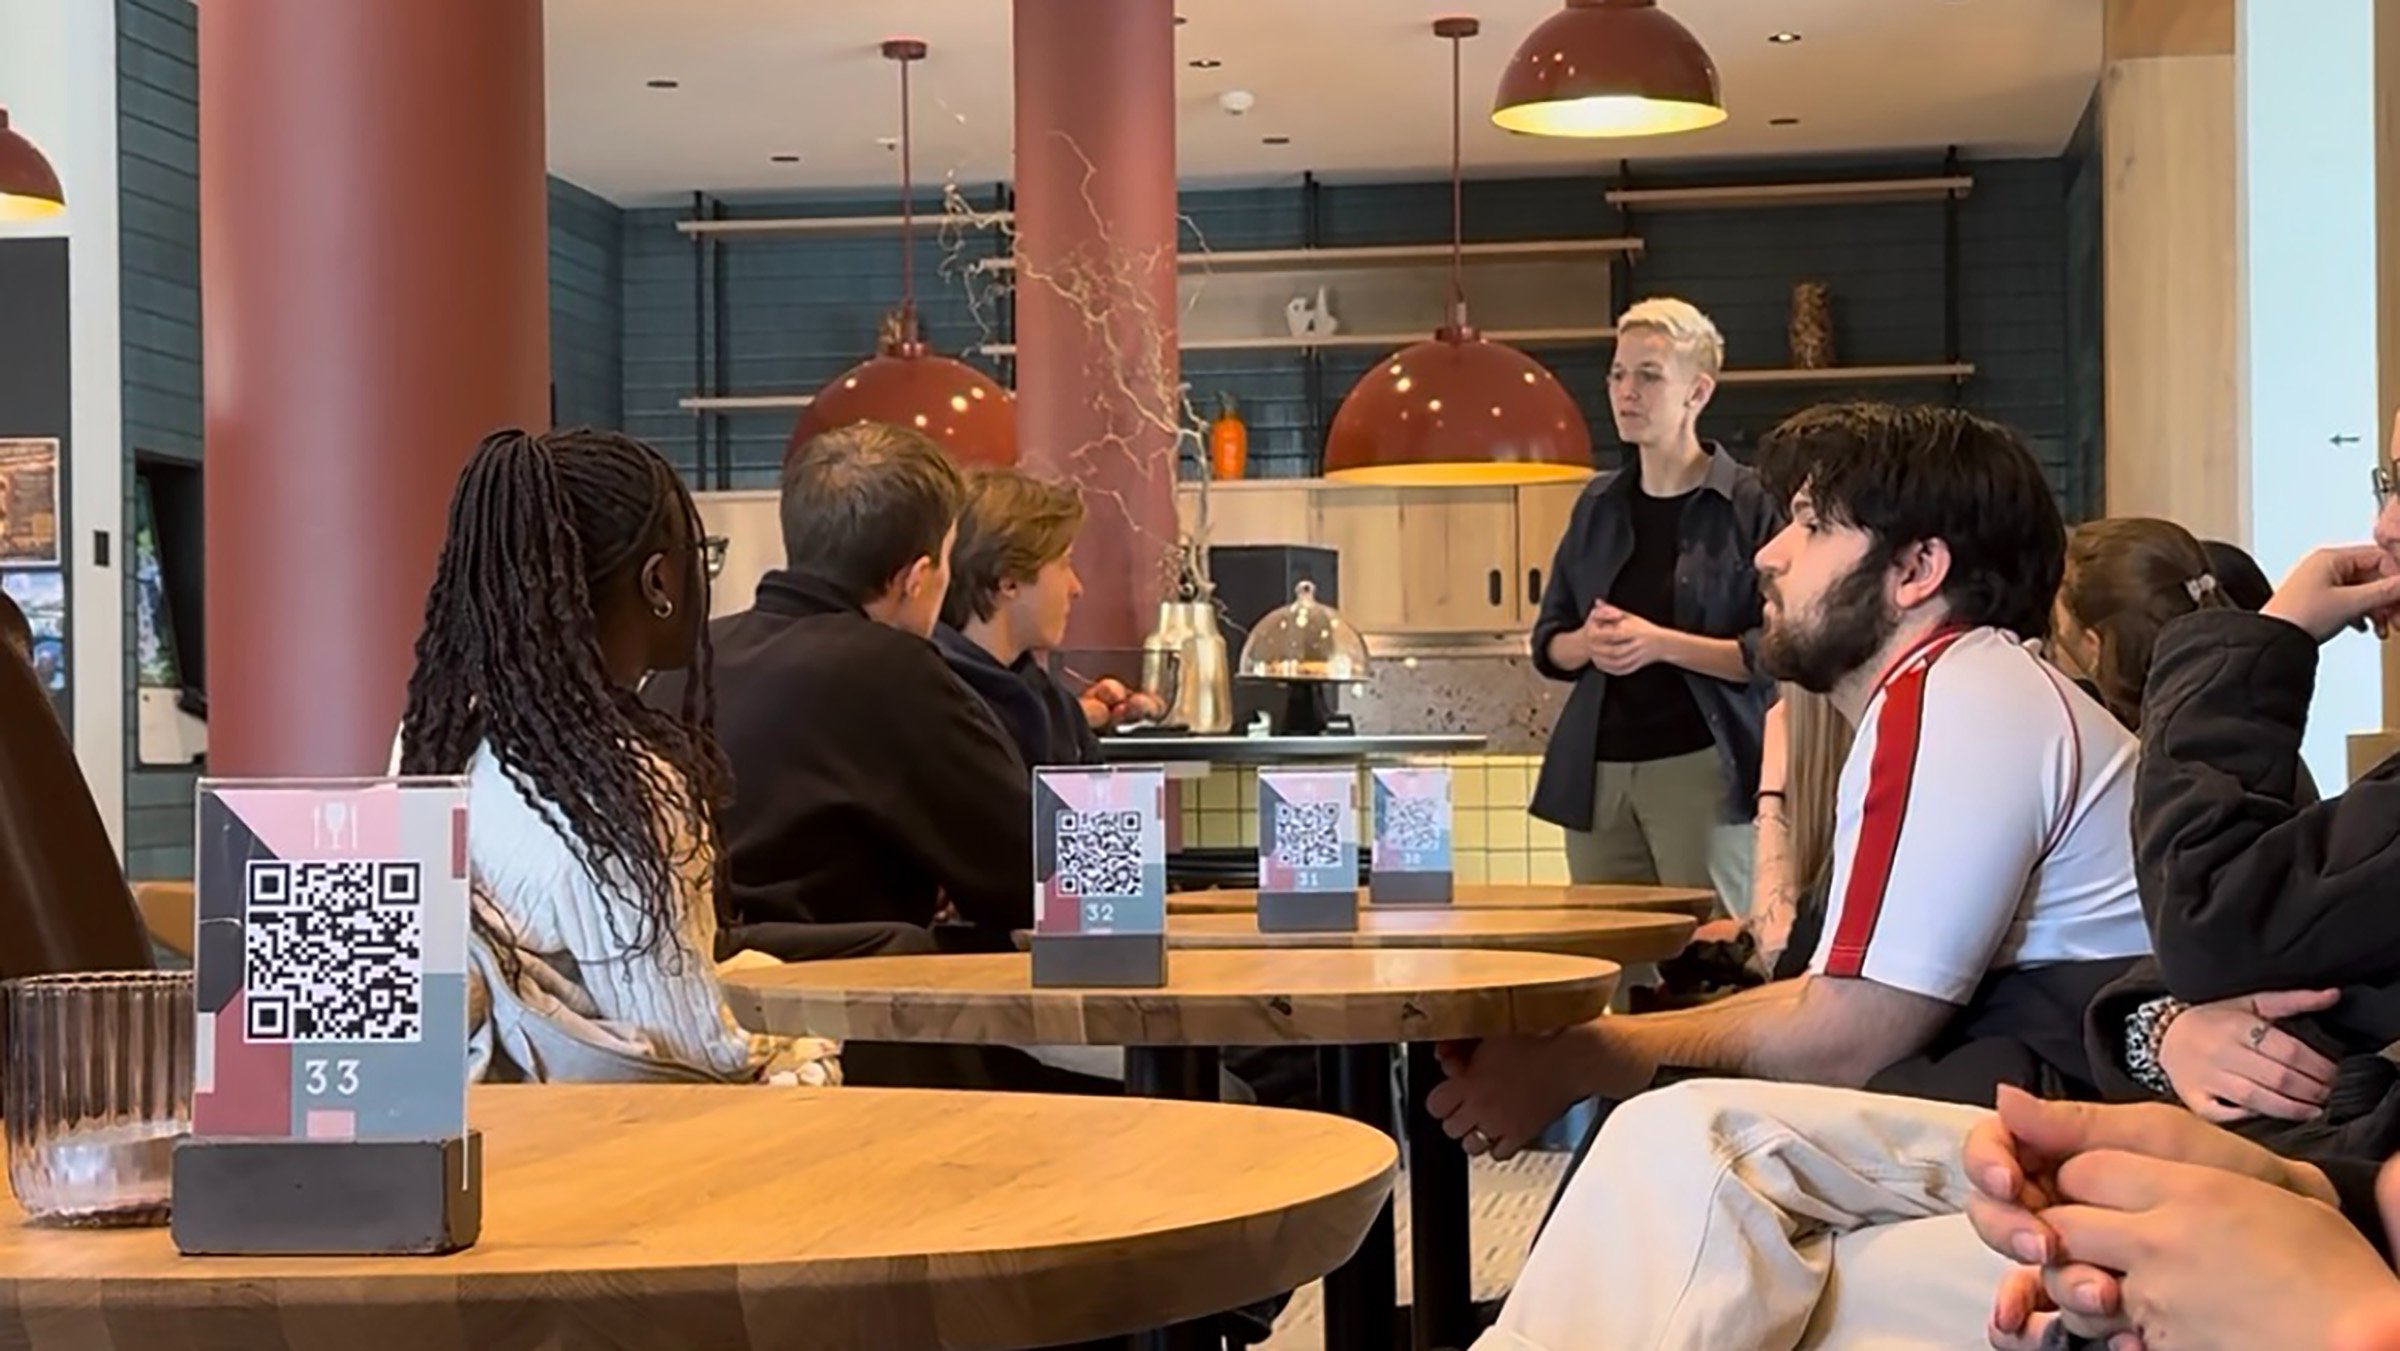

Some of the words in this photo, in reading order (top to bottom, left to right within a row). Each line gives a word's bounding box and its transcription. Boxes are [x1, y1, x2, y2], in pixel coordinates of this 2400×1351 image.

[1299, 871, 1319, 887] 31
[1086, 903, 1114, 920] 32
[305, 1060, 360, 1094] 33
